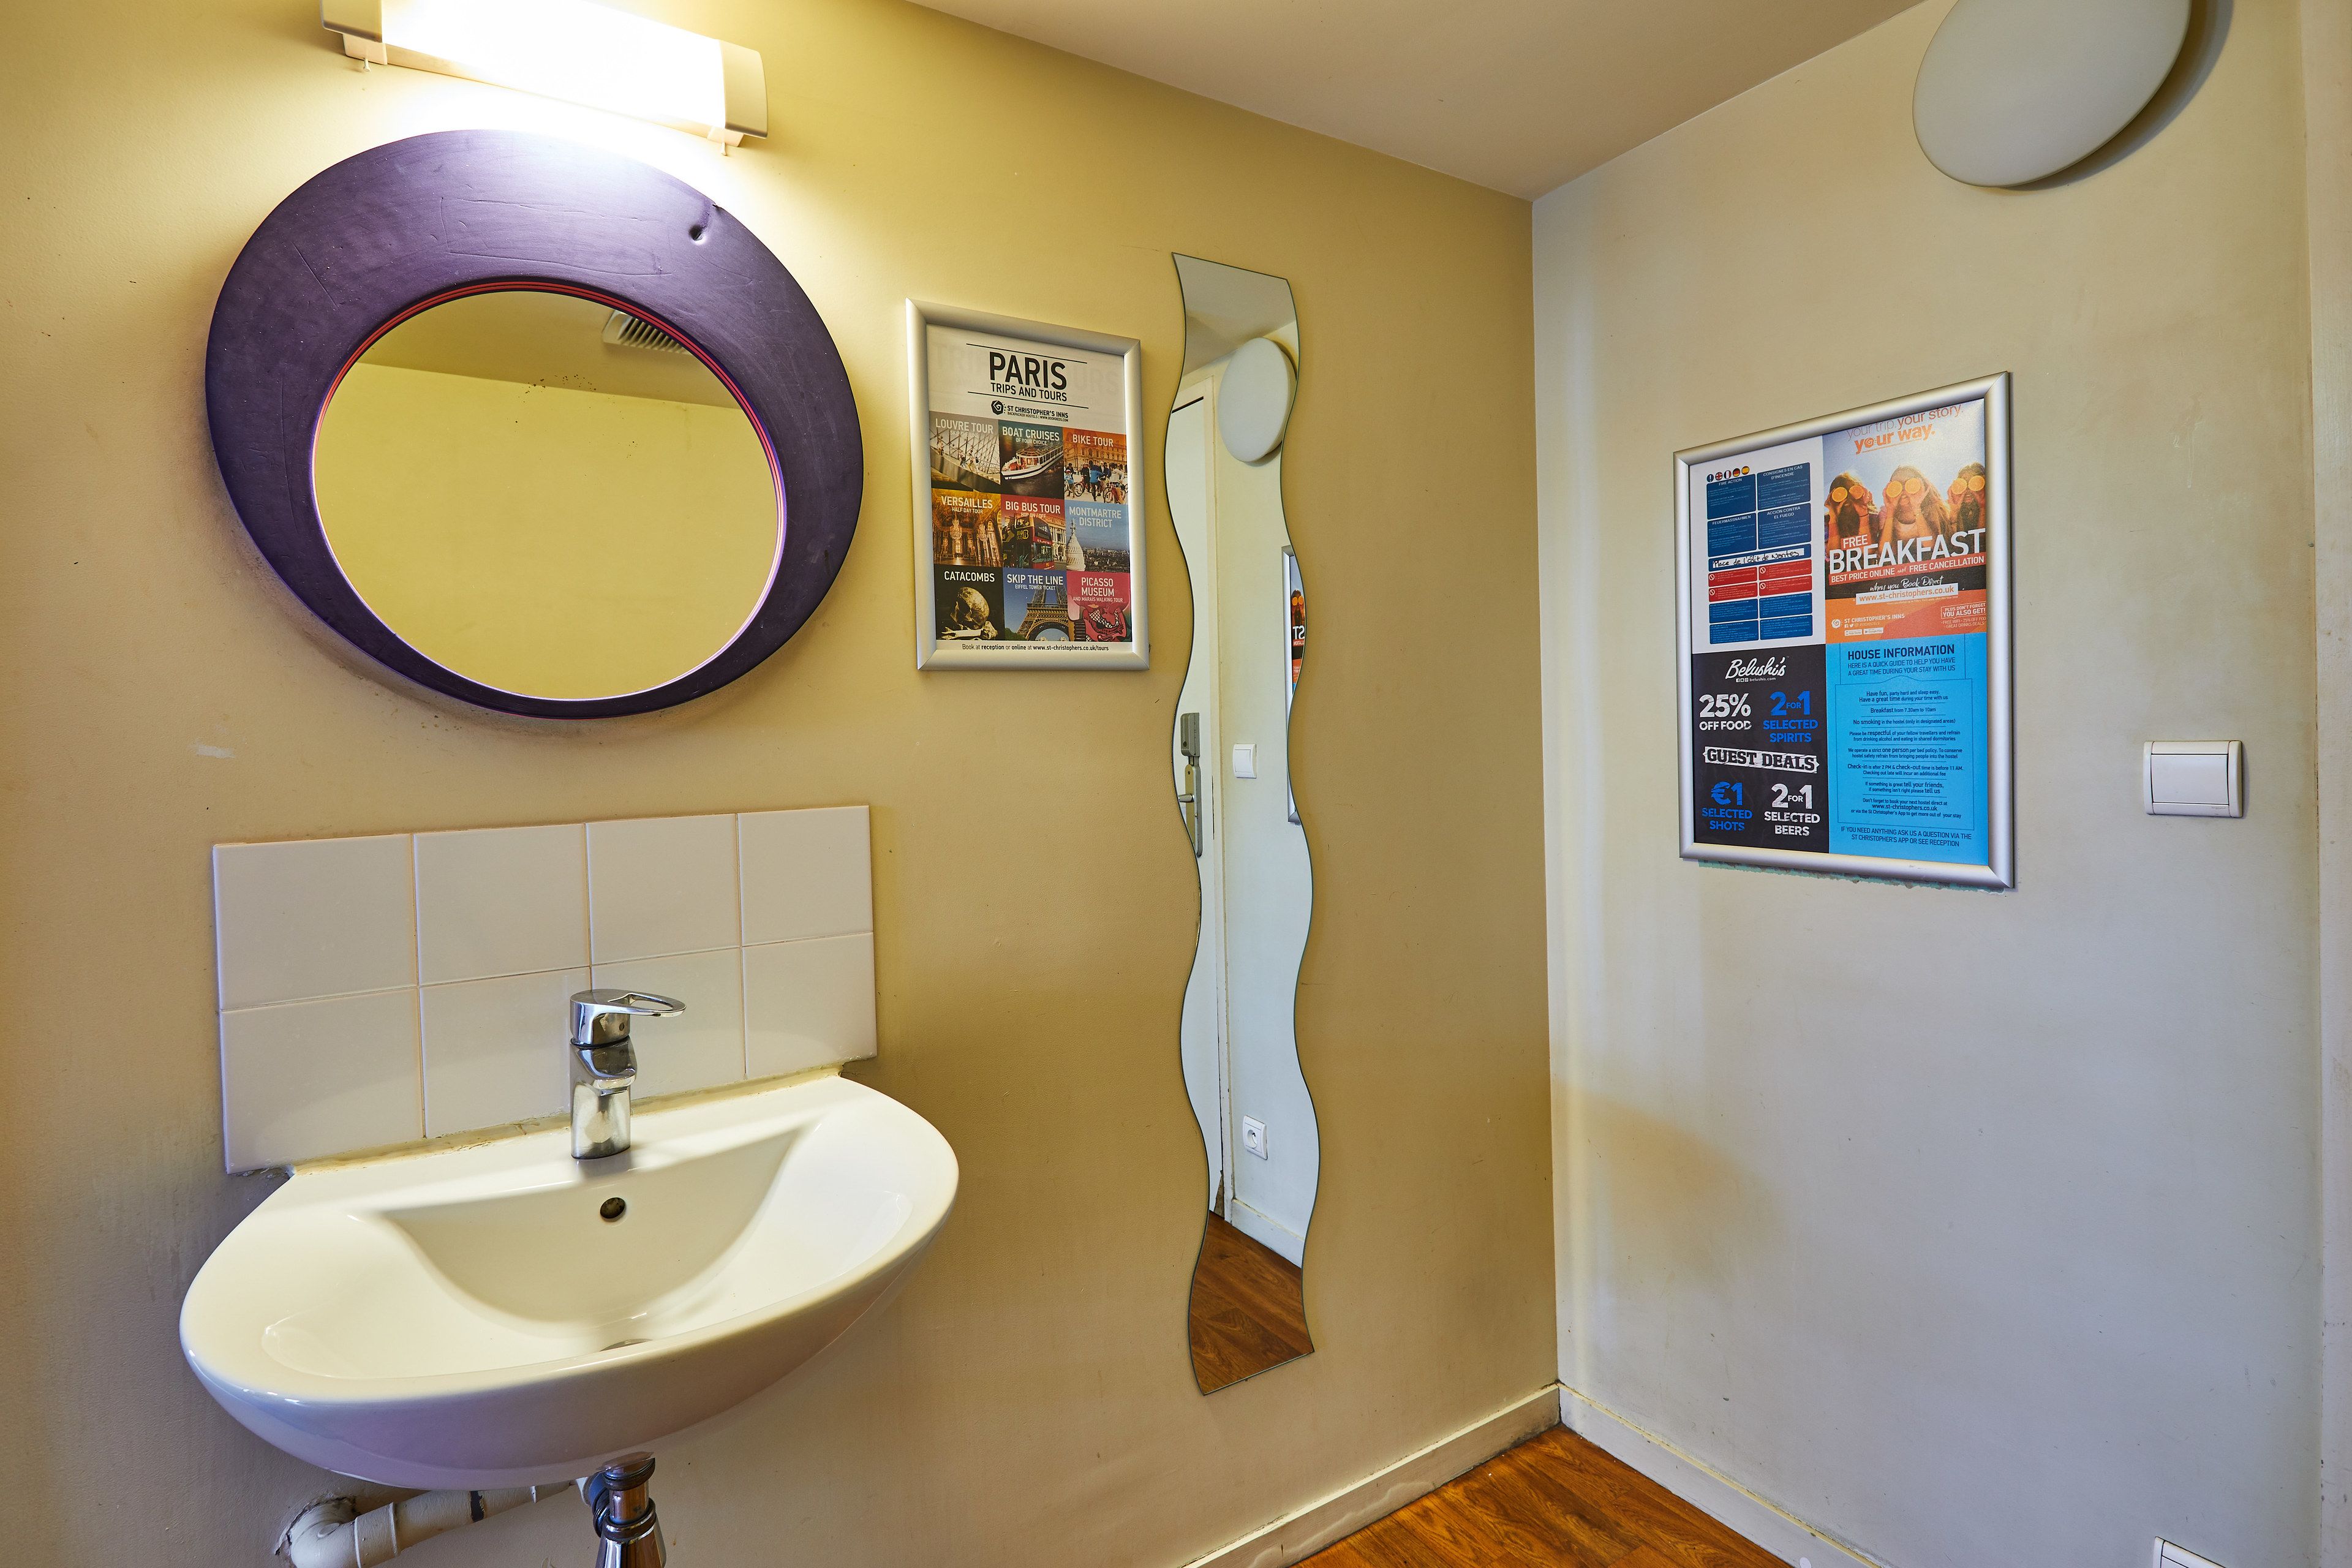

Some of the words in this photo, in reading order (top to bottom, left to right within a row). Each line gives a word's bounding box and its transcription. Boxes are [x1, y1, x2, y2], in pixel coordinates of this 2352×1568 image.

[990, 352, 1066, 390] PARIS
[990, 383, 1016, 394] TRIPS
[1019, 388, 1036, 398] AND
[1039, 390, 1067, 402] TOURS
[1015, 407, 1055, 417] CHRISTOPHER'S
[935, 418, 969, 432] LOUVRE
[971, 423, 993, 434] TOUR
[1847, 425, 1873, 441] your
[1898, 412, 1926, 429] your
[1898, 423, 1936, 441] way.
[1002, 427, 1023, 437] BOAT
[1026, 429, 1060, 441] CRUISES
[1072, 434, 1090, 444] BIKE
[1093, 436, 1114, 447] TOUR
[941, 496, 993, 508] VERSAILLES
[1005, 501, 1019, 510] BIG
[1022, 502, 1038, 512] BUS
[1040, 503, 1060, 514] TOUR
[1069, 507, 1121, 519] MONTMARTRE
[1079, 518, 1112, 528] DISTRICT
[1713, 515, 1751, 525] FEUERMASSNAHMEN
[1843, 535, 1868, 549] FREE
[1771, 551, 1799, 559] Nantes
[1830, 529, 1986, 574] BREAKFAST
[1849, 572, 1868, 581] PRICE
[1869, 568, 1894, 578] ONLINE
[1929, 556, 1984, 570] CANCELLATION
[944, 571, 995, 582] CATACOMBS
[1007, 574, 1027, 583] SKIP
[1028, 575, 1043, 584] THE
[1046, 576, 1063, 586] LINE
[1081, 577, 1114, 586] PICASSO
[1870, 582, 1886, 592] when
[1901, 578, 1920, 588] Book
[1921, 576, 1943, 586] Direct
[1081, 587, 1114, 597] MUSEUM
[1860, 586, 1954, 601] www.st-christophers.co.uk
[1848, 649, 1880, 660] HOUSE
[1884, 644, 1954, 658] INFORMATION
[1725, 657, 1786, 679] Belushi's
[1699, 693, 1751, 717] 25%
[1770, 692, 1787, 715] 2
[1798, 691, 1810, 715] 1
[1699, 721, 1719, 731] OFF
[1721, 721, 1752, 730] FOOD
[1763, 720, 1819, 729] SELECTED
[1770, 733, 1812, 742] SPIRITS
[1707, 748, 1757, 765] GUEST
[1762, 753, 1815, 771] DEALS
[1711, 781, 1743, 805] €1
[1771, 783, 1789, 808] 2
[1800, 785, 1812, 809] 1
[1702, 808, 1753, 819] SELECTED
[1764, 812, 1820, 823] SELECTED
[1709, 821, 1744, 831] SHOTS
[1775, 825, 1810, 836] BEERS
